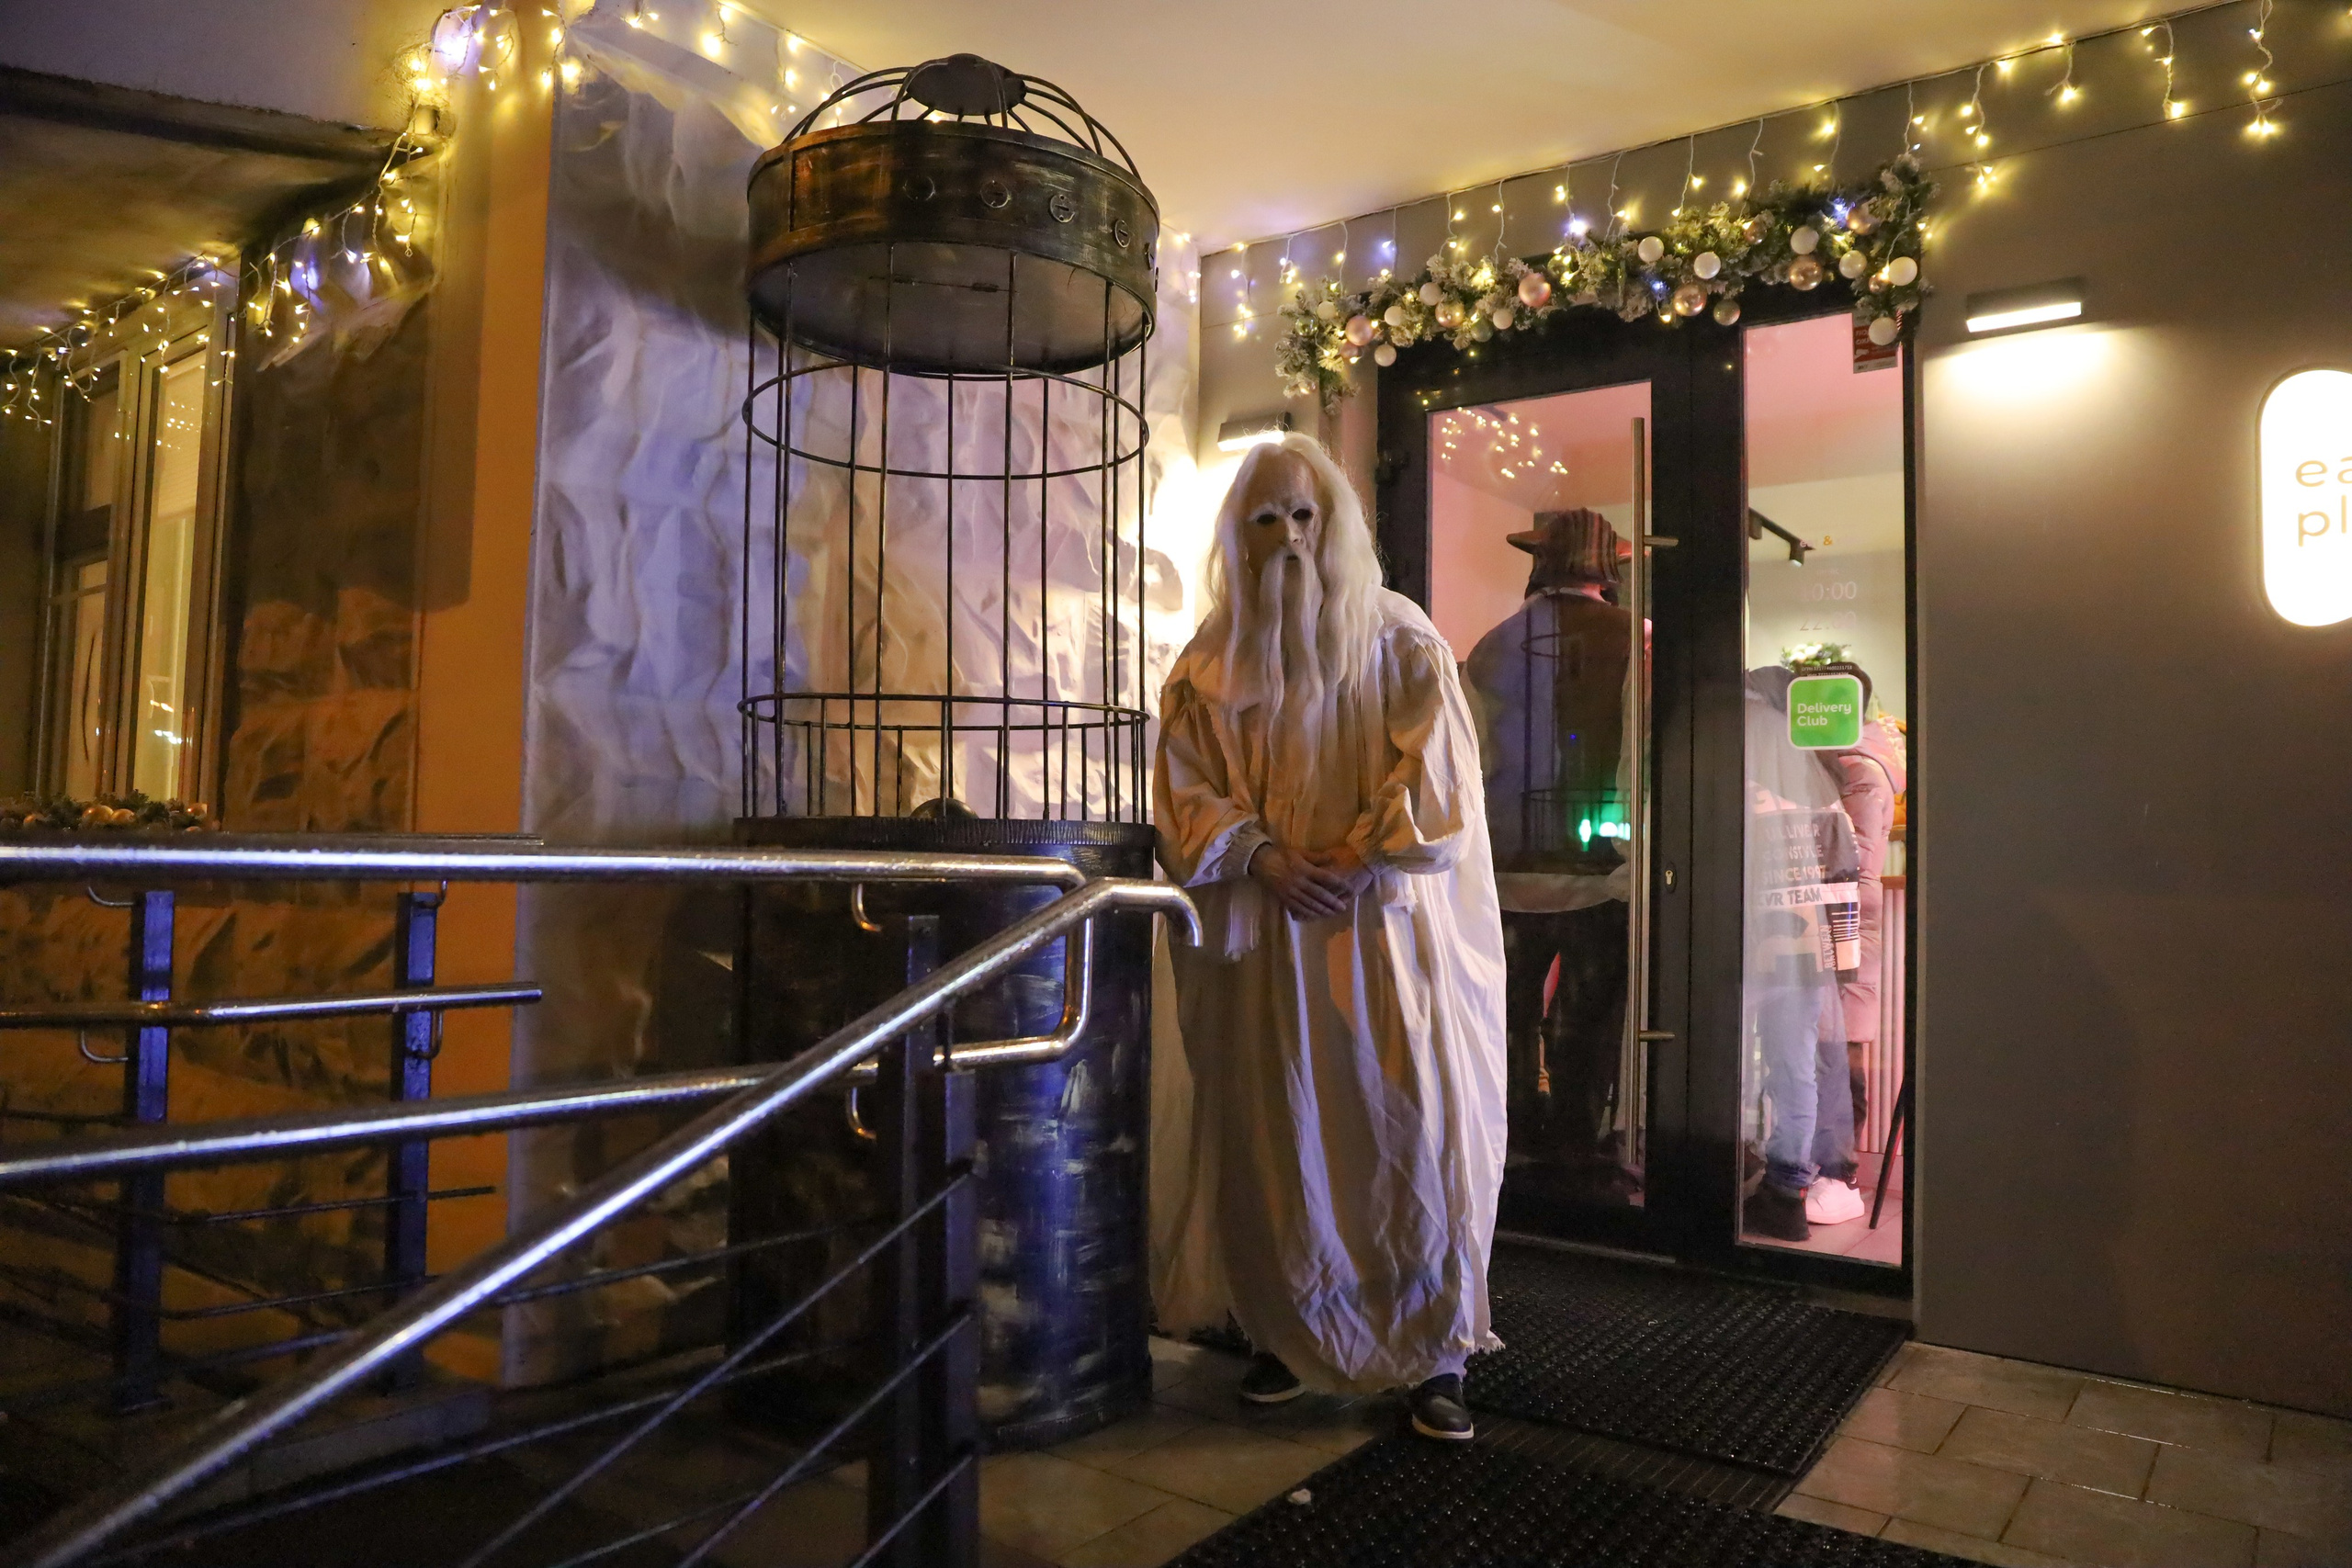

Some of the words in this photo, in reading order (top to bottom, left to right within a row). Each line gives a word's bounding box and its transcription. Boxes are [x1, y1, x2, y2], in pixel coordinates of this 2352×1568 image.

[1797, 702, 1852, 716] Delivery
[1797, 716, 1828, 727] Club
[1787, 887, 1823, 905] TEAM
